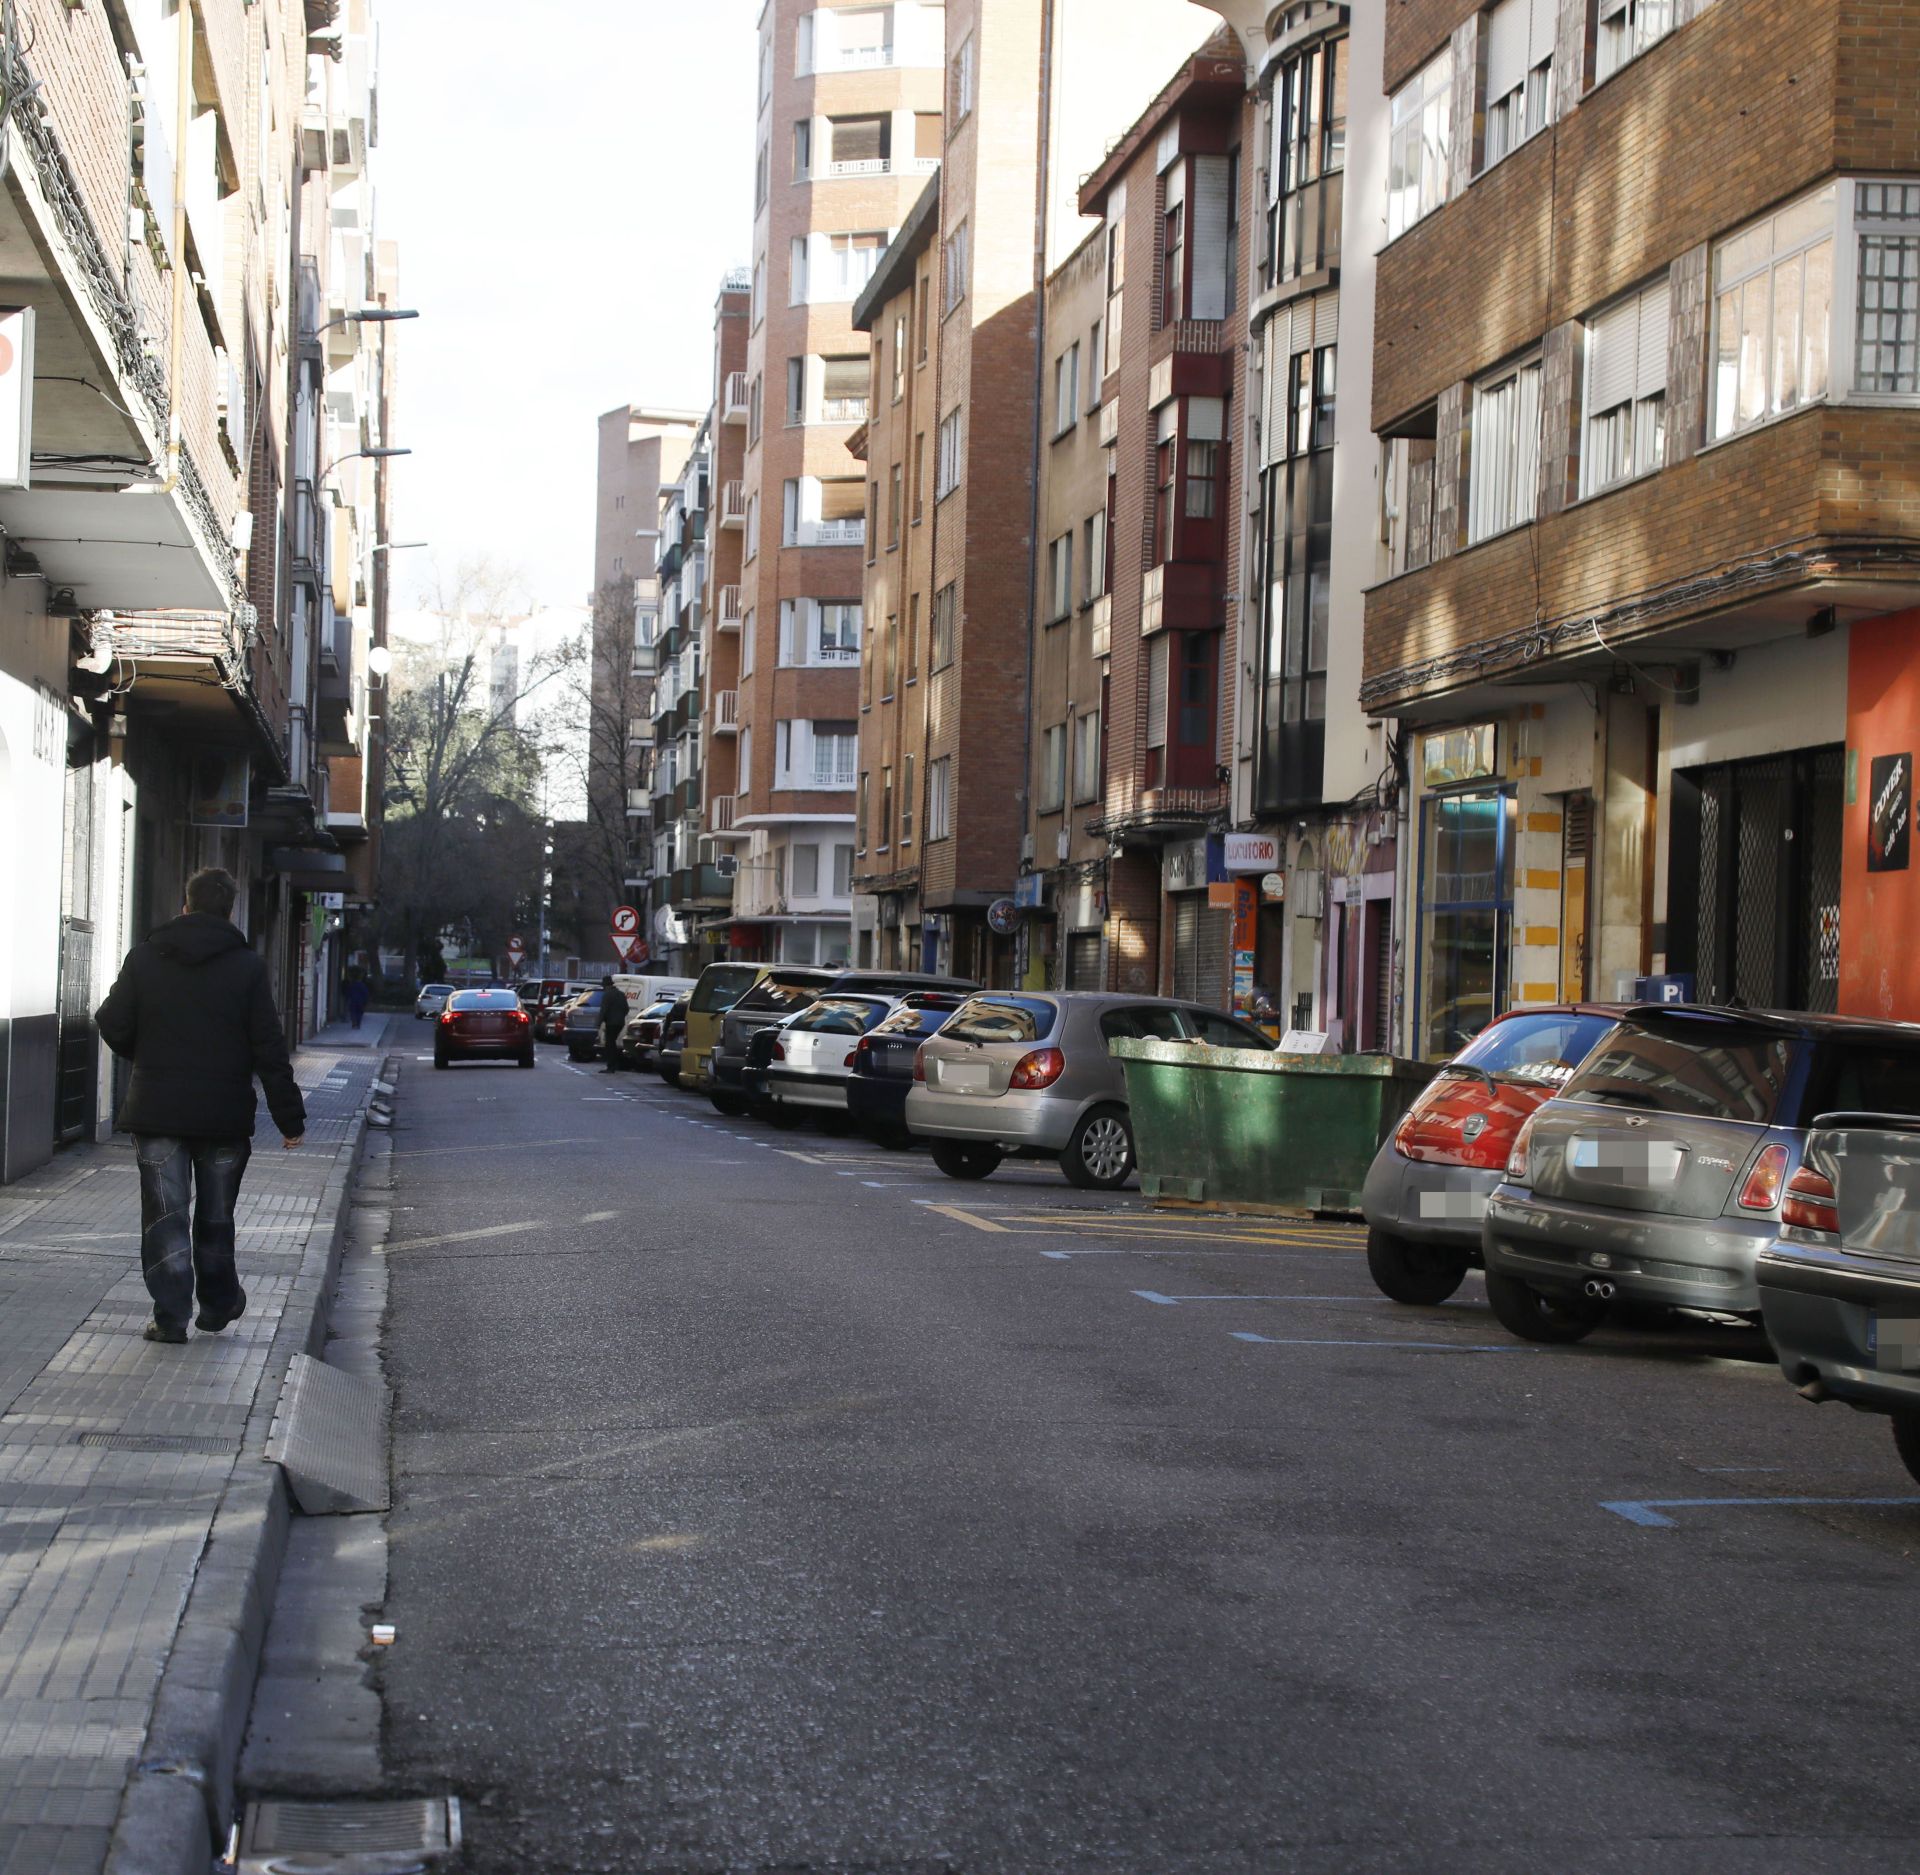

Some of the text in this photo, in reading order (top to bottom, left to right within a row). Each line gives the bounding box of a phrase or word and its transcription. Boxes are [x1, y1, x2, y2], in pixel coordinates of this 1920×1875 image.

[1874, 758, 1903, 823] COVER
[1227, 841, 1274, 860] LOCUTORIO
[1663, 984, 1679, 1002] P
